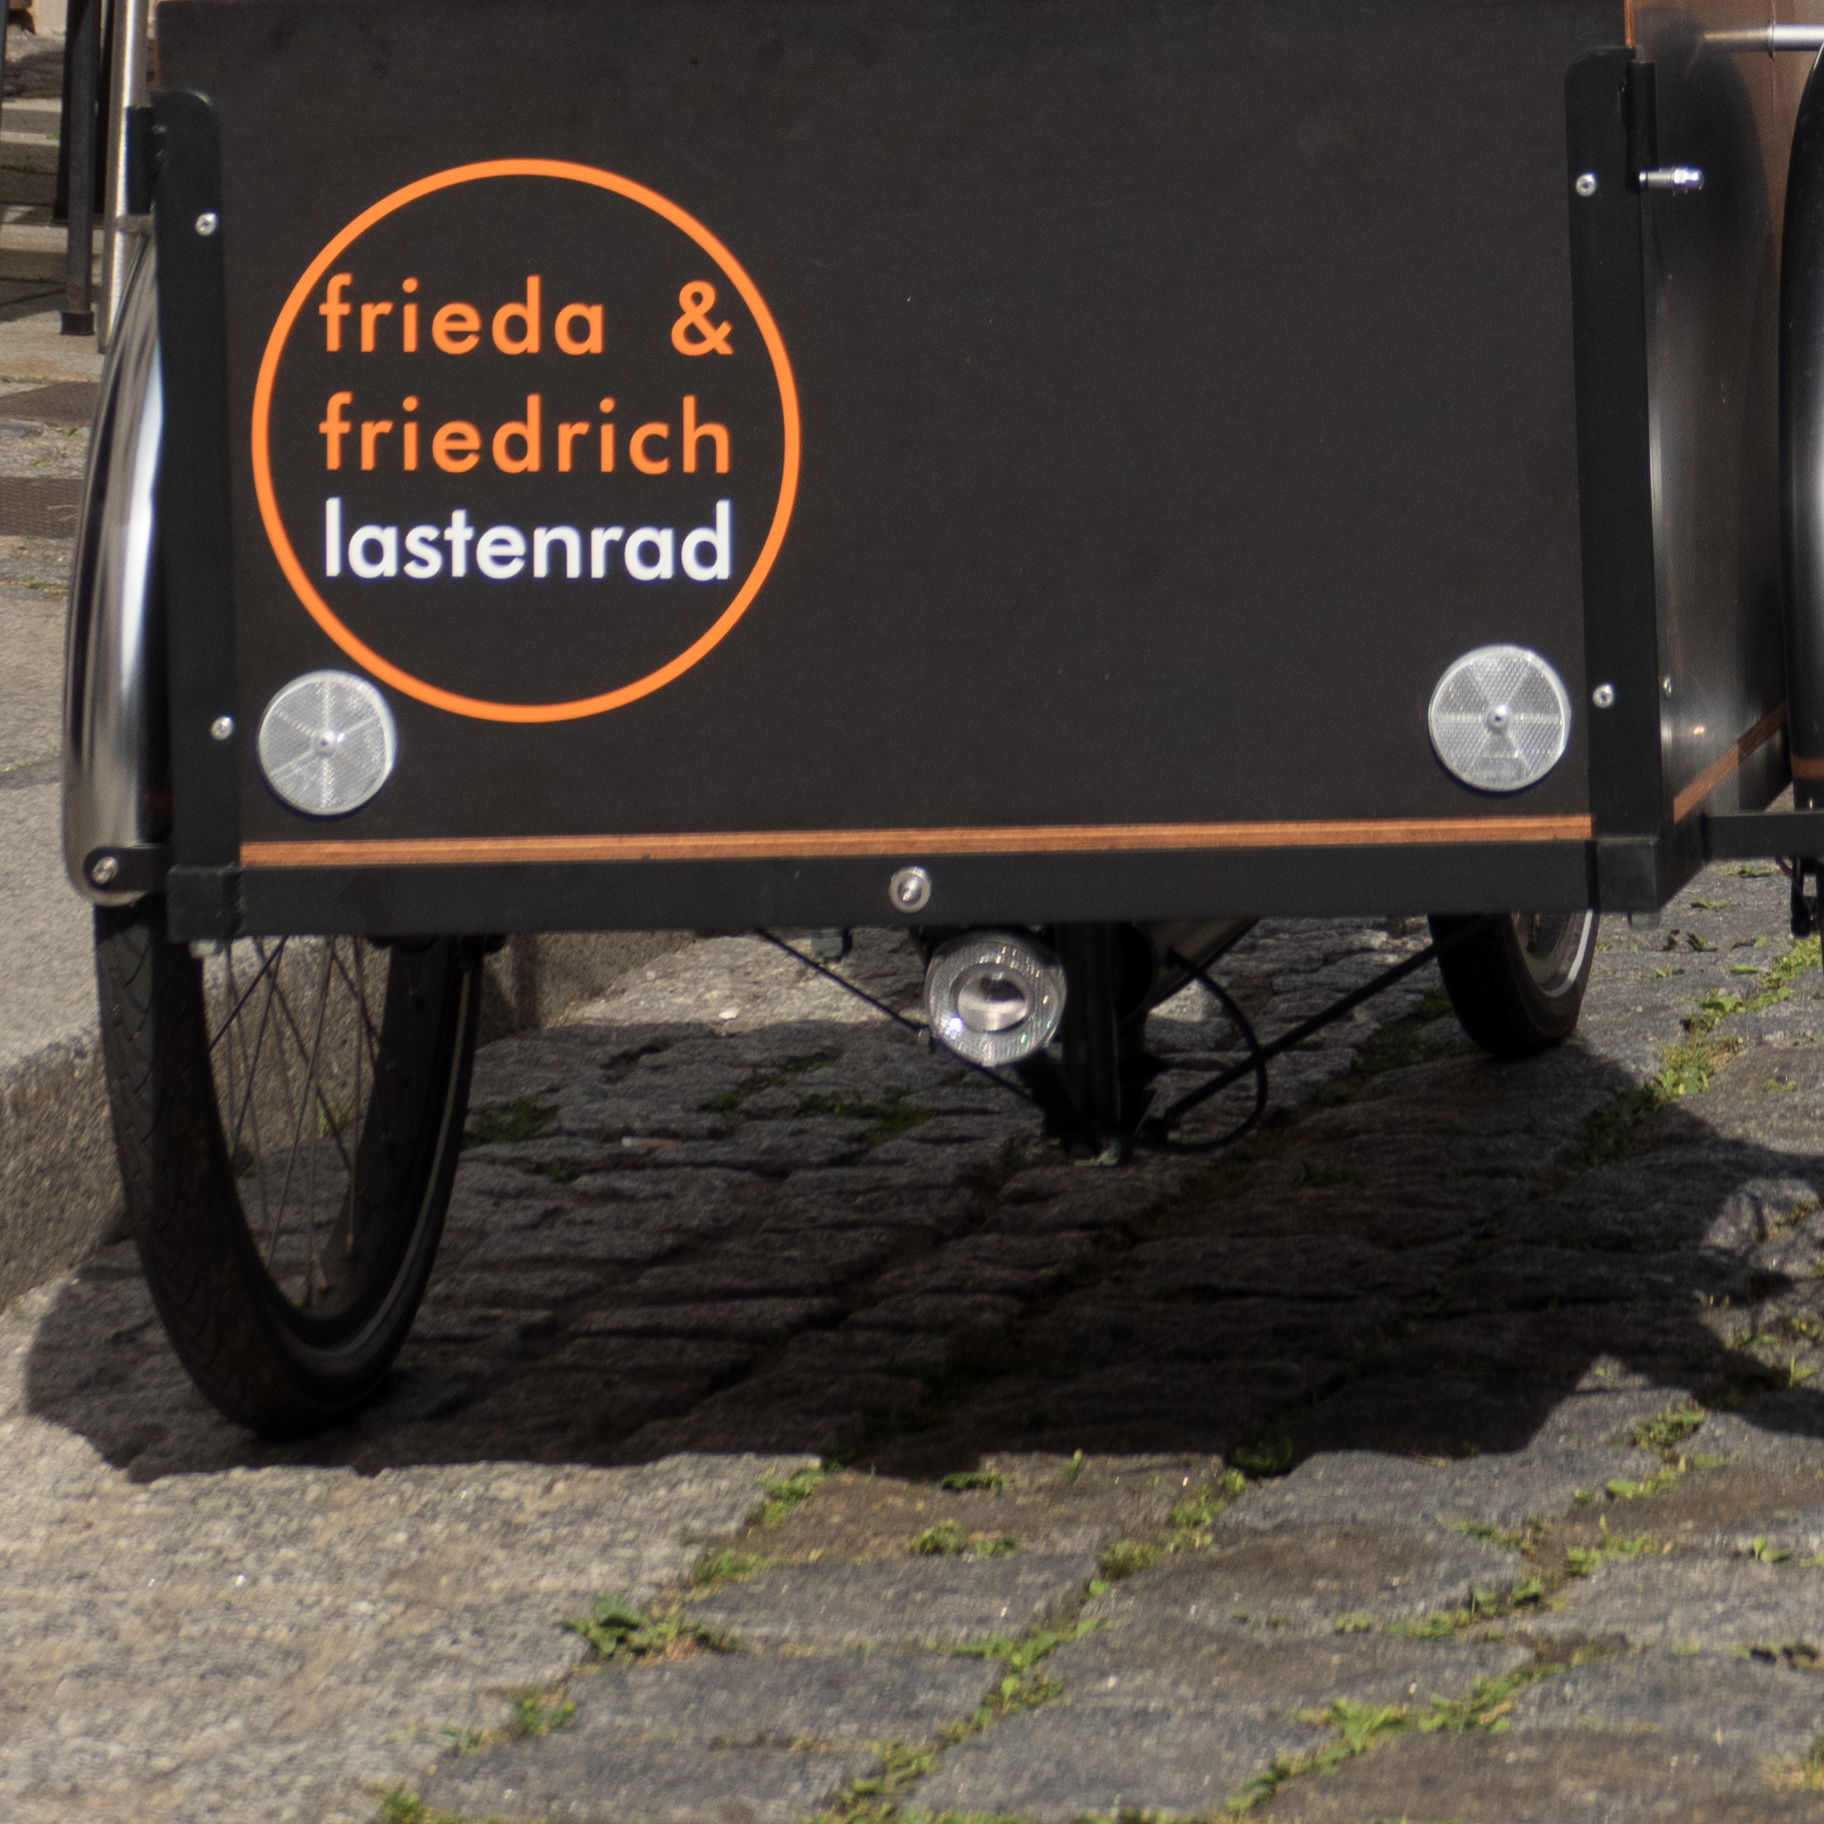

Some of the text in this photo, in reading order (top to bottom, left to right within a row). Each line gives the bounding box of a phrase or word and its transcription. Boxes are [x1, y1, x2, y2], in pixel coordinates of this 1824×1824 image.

[318, 272, 734, 356] frieda &
[318, 391, 731, 475] friedrich
[325, 497, 731, 582] lastenrad
